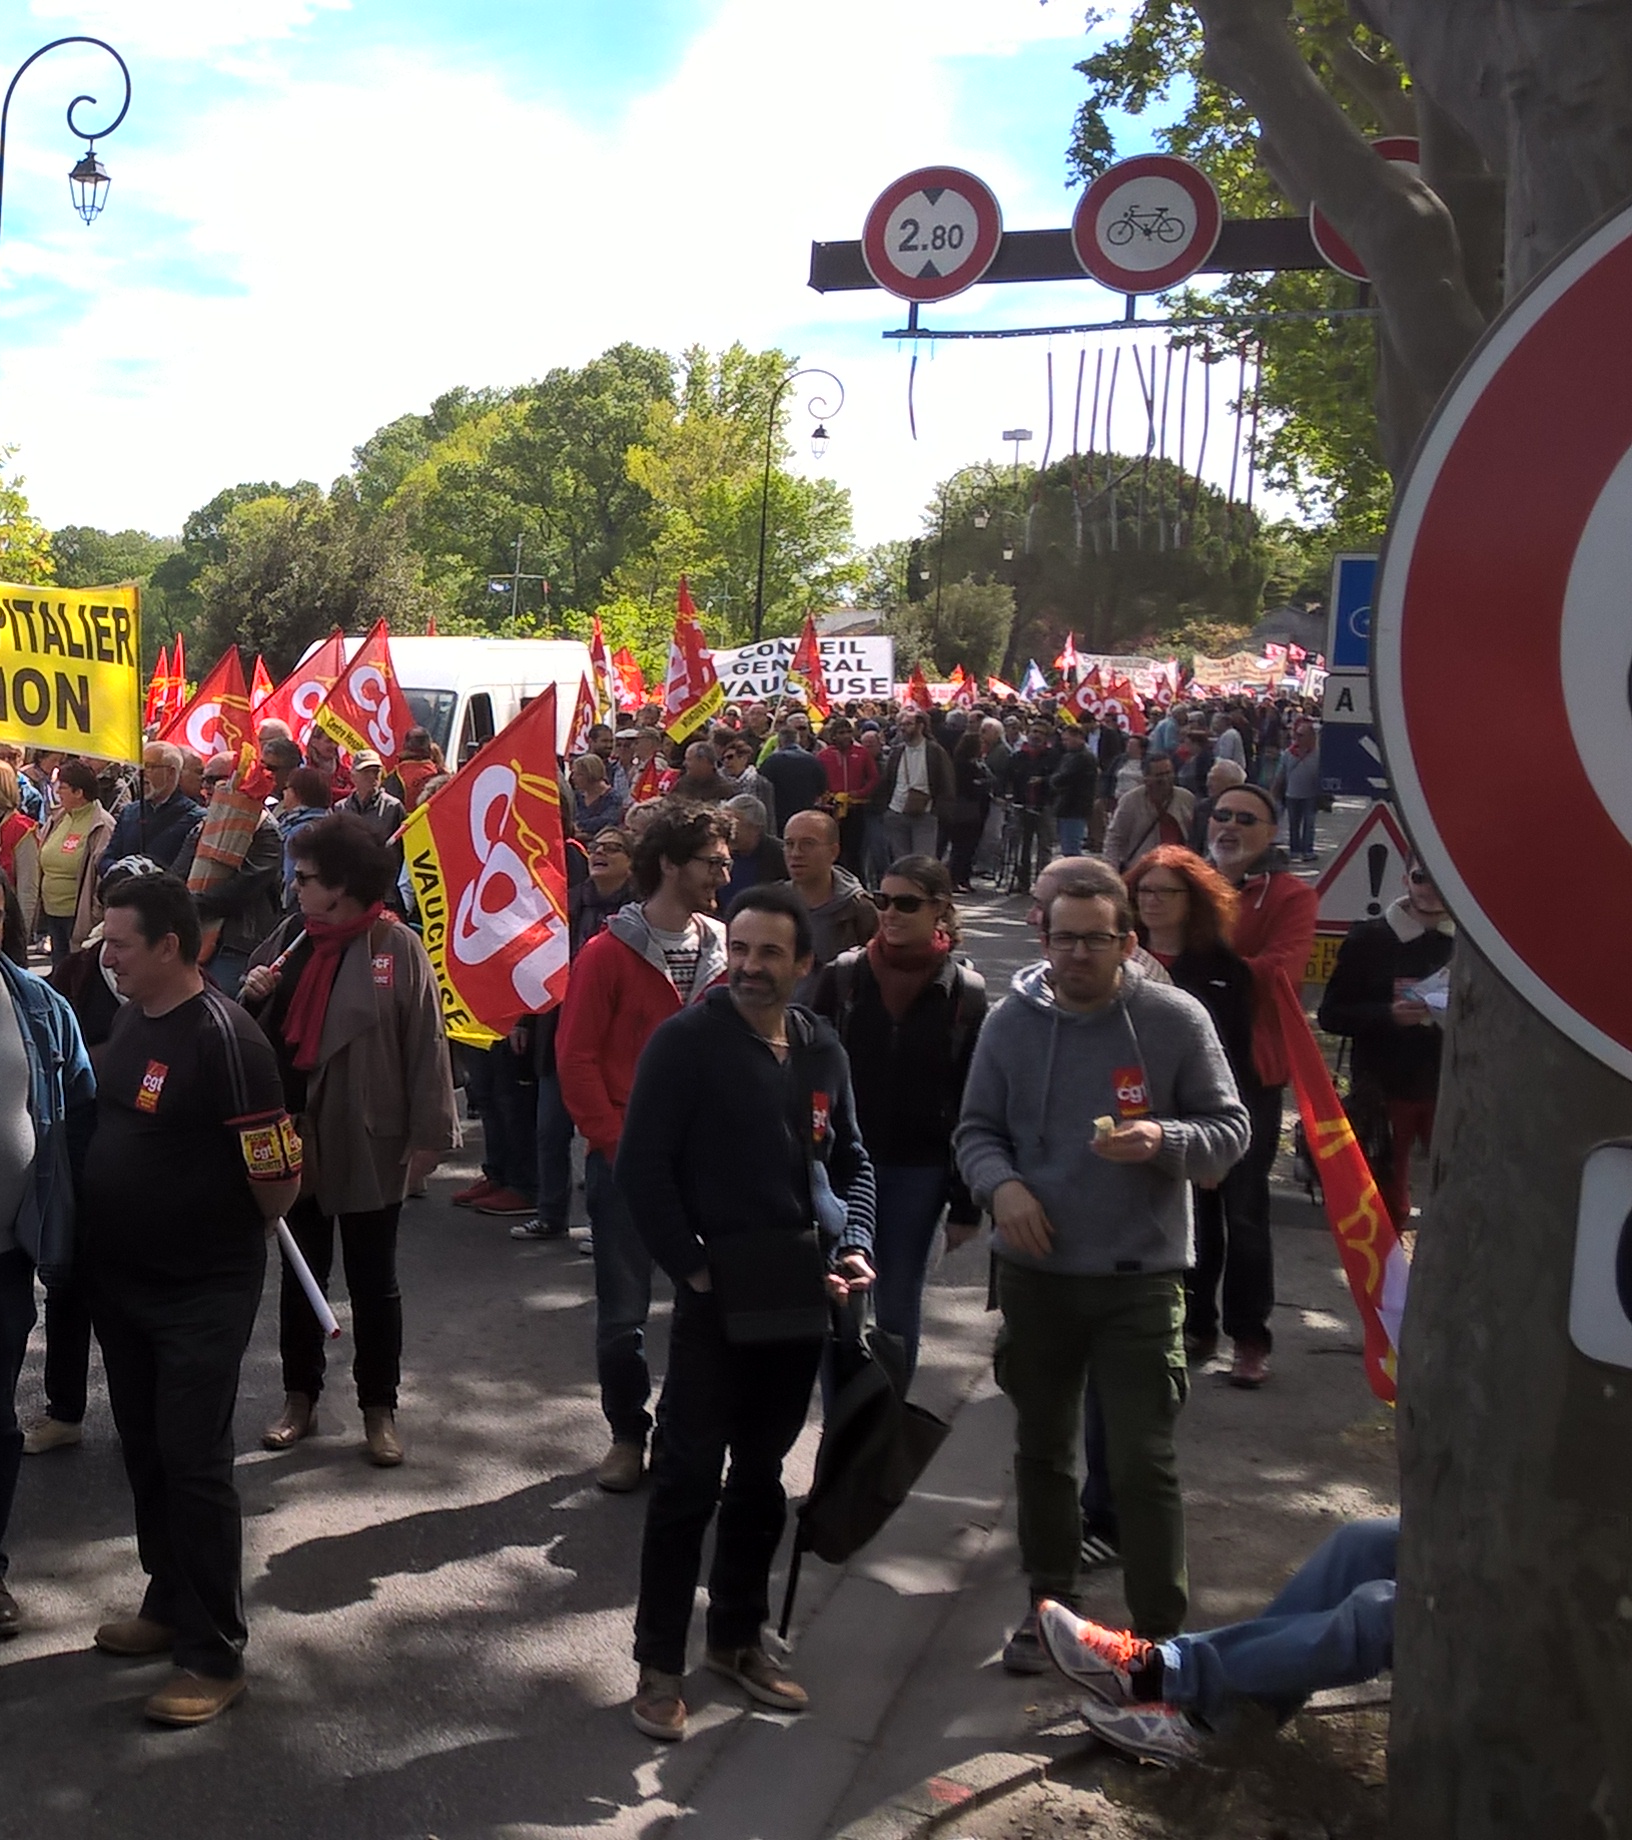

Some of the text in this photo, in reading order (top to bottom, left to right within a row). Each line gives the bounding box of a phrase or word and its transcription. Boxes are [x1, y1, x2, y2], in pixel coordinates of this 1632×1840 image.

[898, 218, 964, 252] 2.80
[737, 641, 867, 660] CONEIL
[731, 659, 873, 676] GENRAL
[718, 676, 889, 698] VAUCUSE
[1334, 687, 1355, 712] A
[454, 764, 570, 1011] cgt
[142, 1073, 165, 1093] cgt
[253, 1144, 274, 1160] cgt
